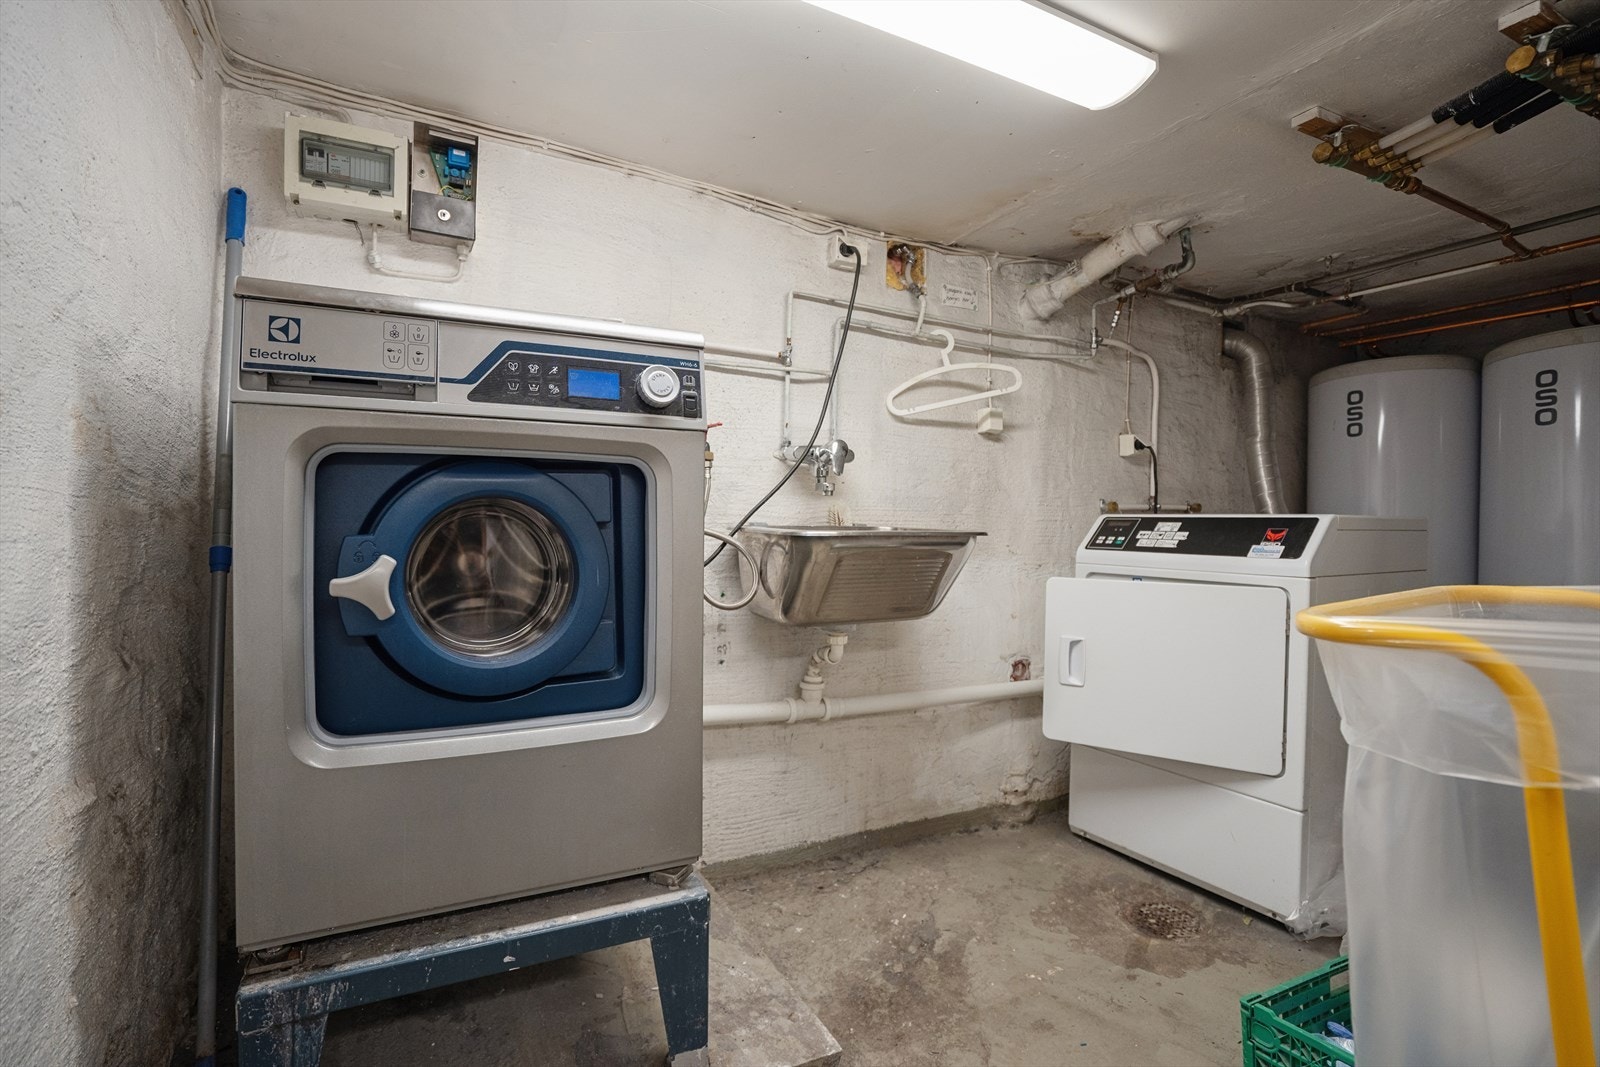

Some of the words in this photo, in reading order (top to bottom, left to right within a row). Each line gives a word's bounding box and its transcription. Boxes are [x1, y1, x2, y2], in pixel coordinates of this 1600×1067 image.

[249, 347, 317, 363] Electrolux
[1346, 390, 1363, 437] OSO
[1534, 369, 1558, 426] OSO
